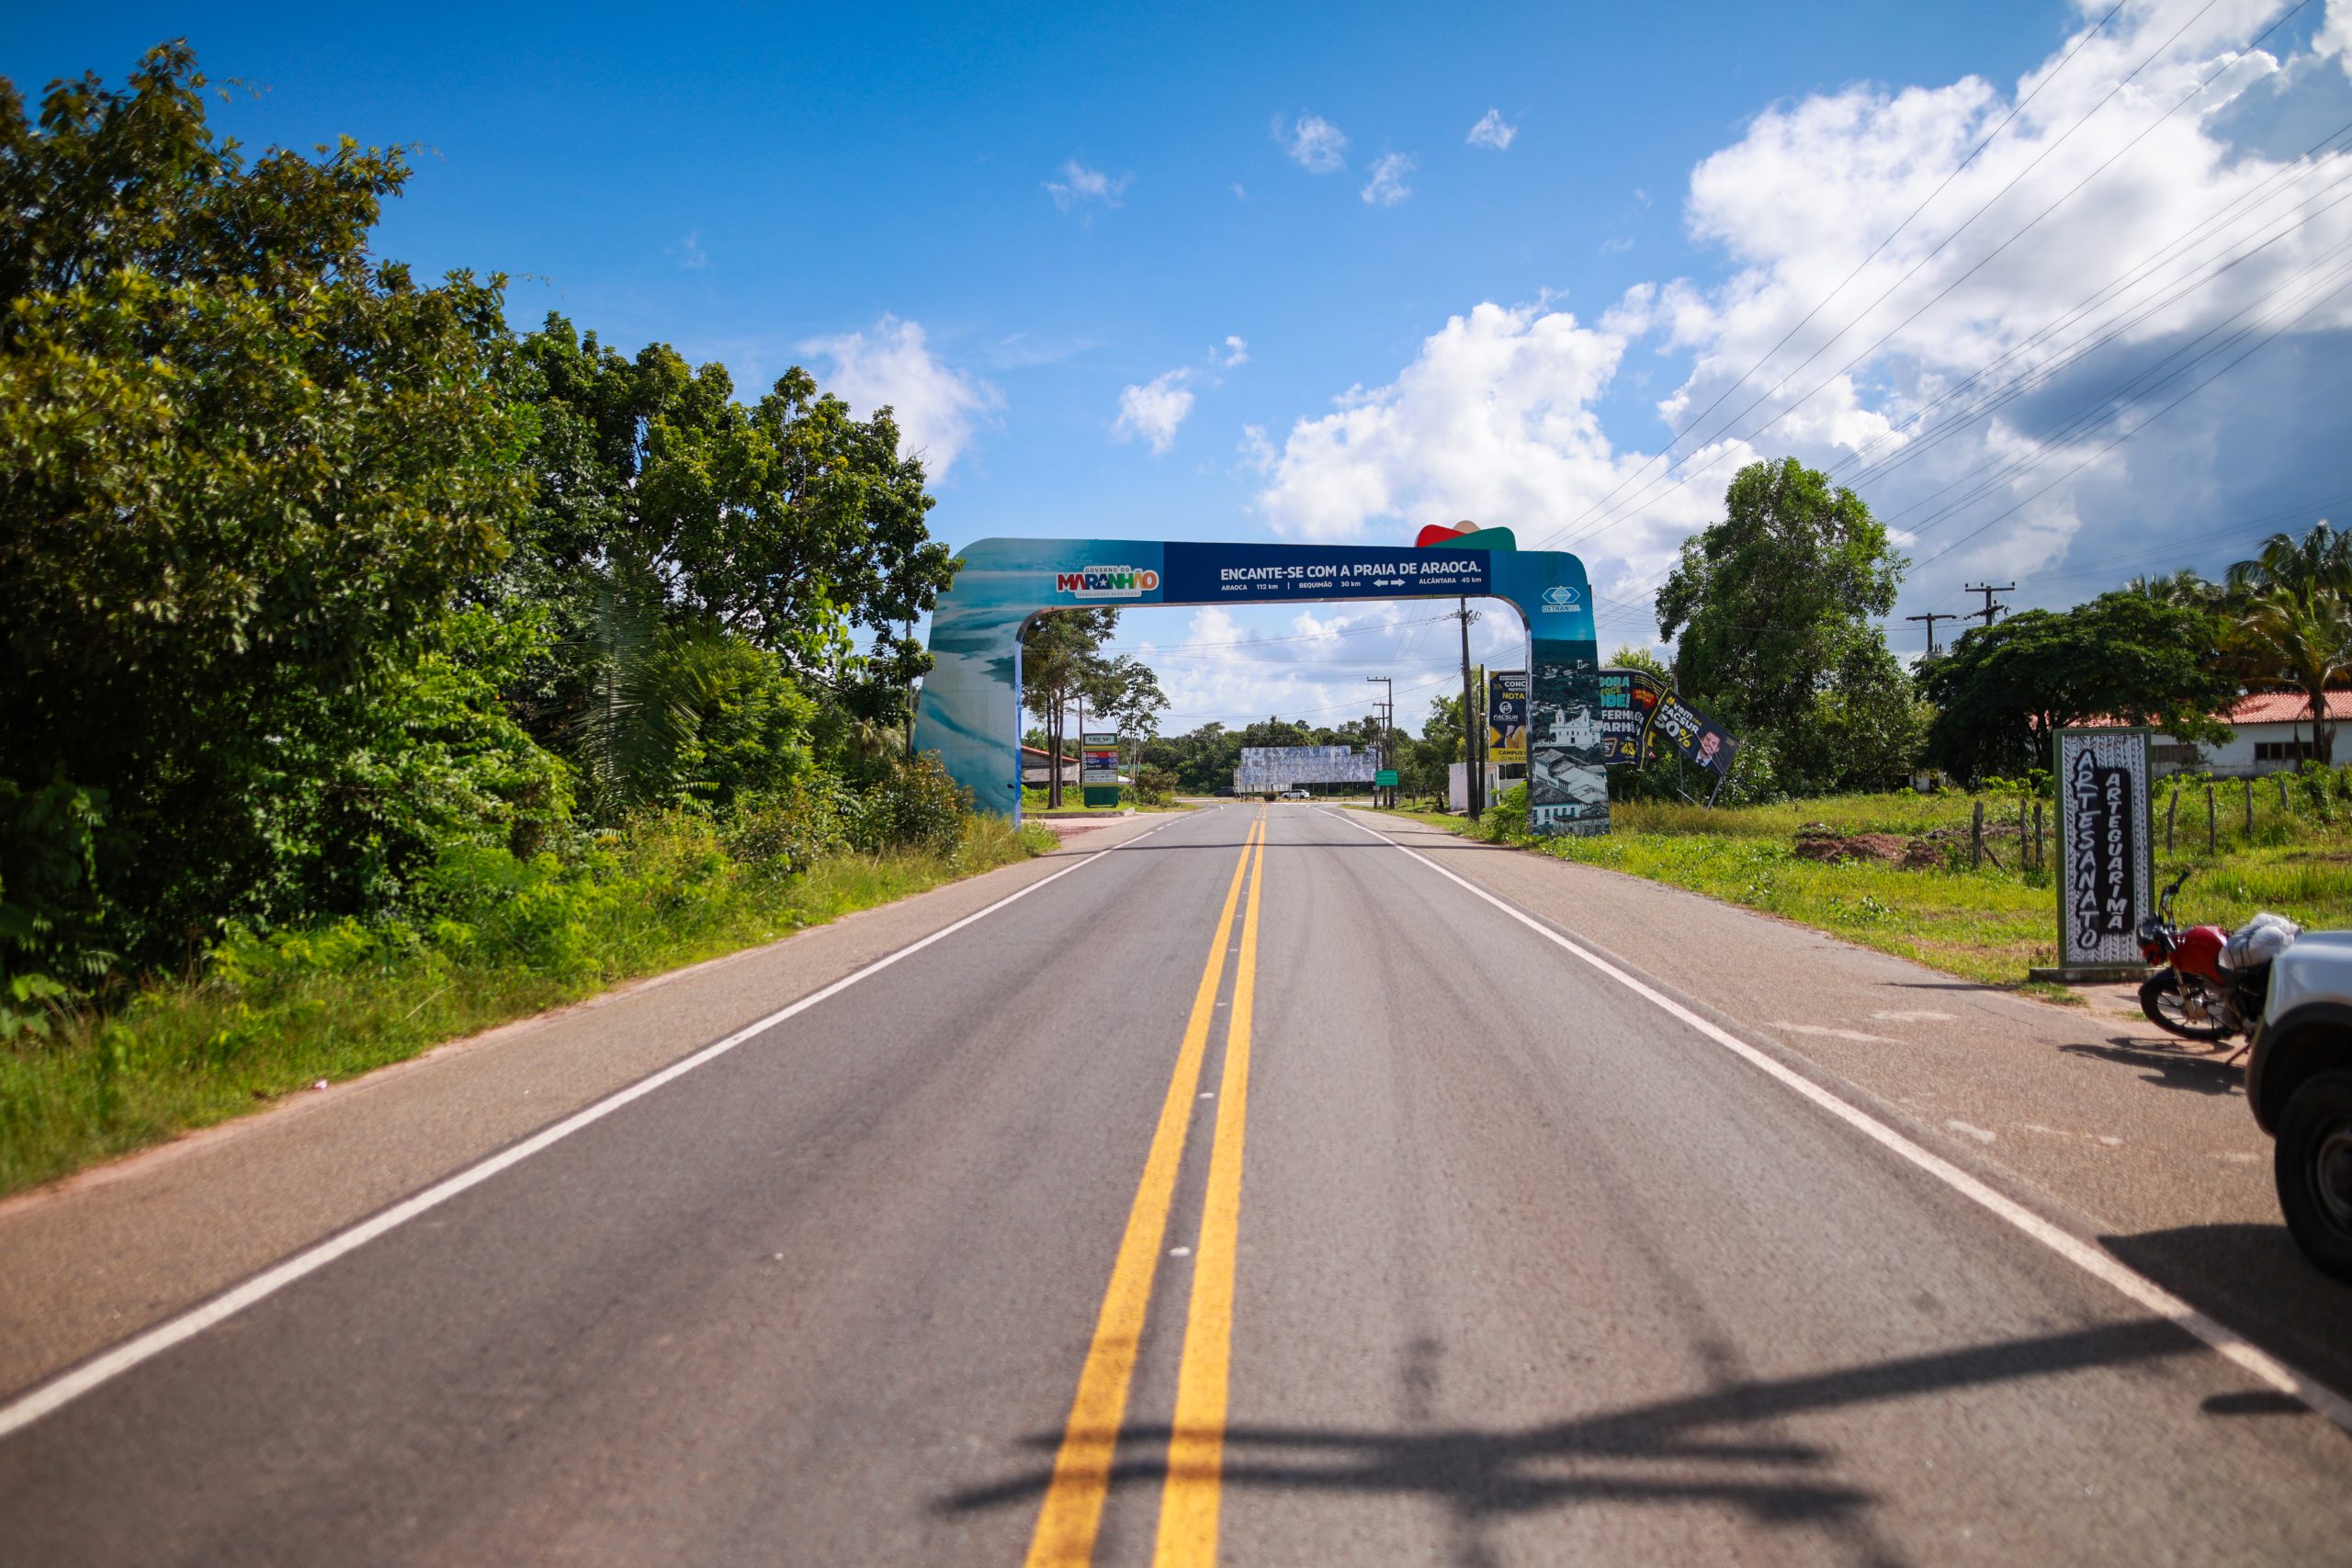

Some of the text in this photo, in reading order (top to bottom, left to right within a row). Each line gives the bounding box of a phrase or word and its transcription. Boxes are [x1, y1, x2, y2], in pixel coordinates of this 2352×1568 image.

[1057, 570, 1158, 591] MARANHÃO
[1220, 560, 1482, 581] ENCANTE-SE COM A PRAIA DE ARAOCA.
[1298, 581, 1333, 589] BEQUIMÃO
[1661, 704, 1700, 733] FACSUR
[2075, 750, 2101, 948] ARTESANATO
[2106, 773, 2129, 929] ARTEGUARIMÃ
